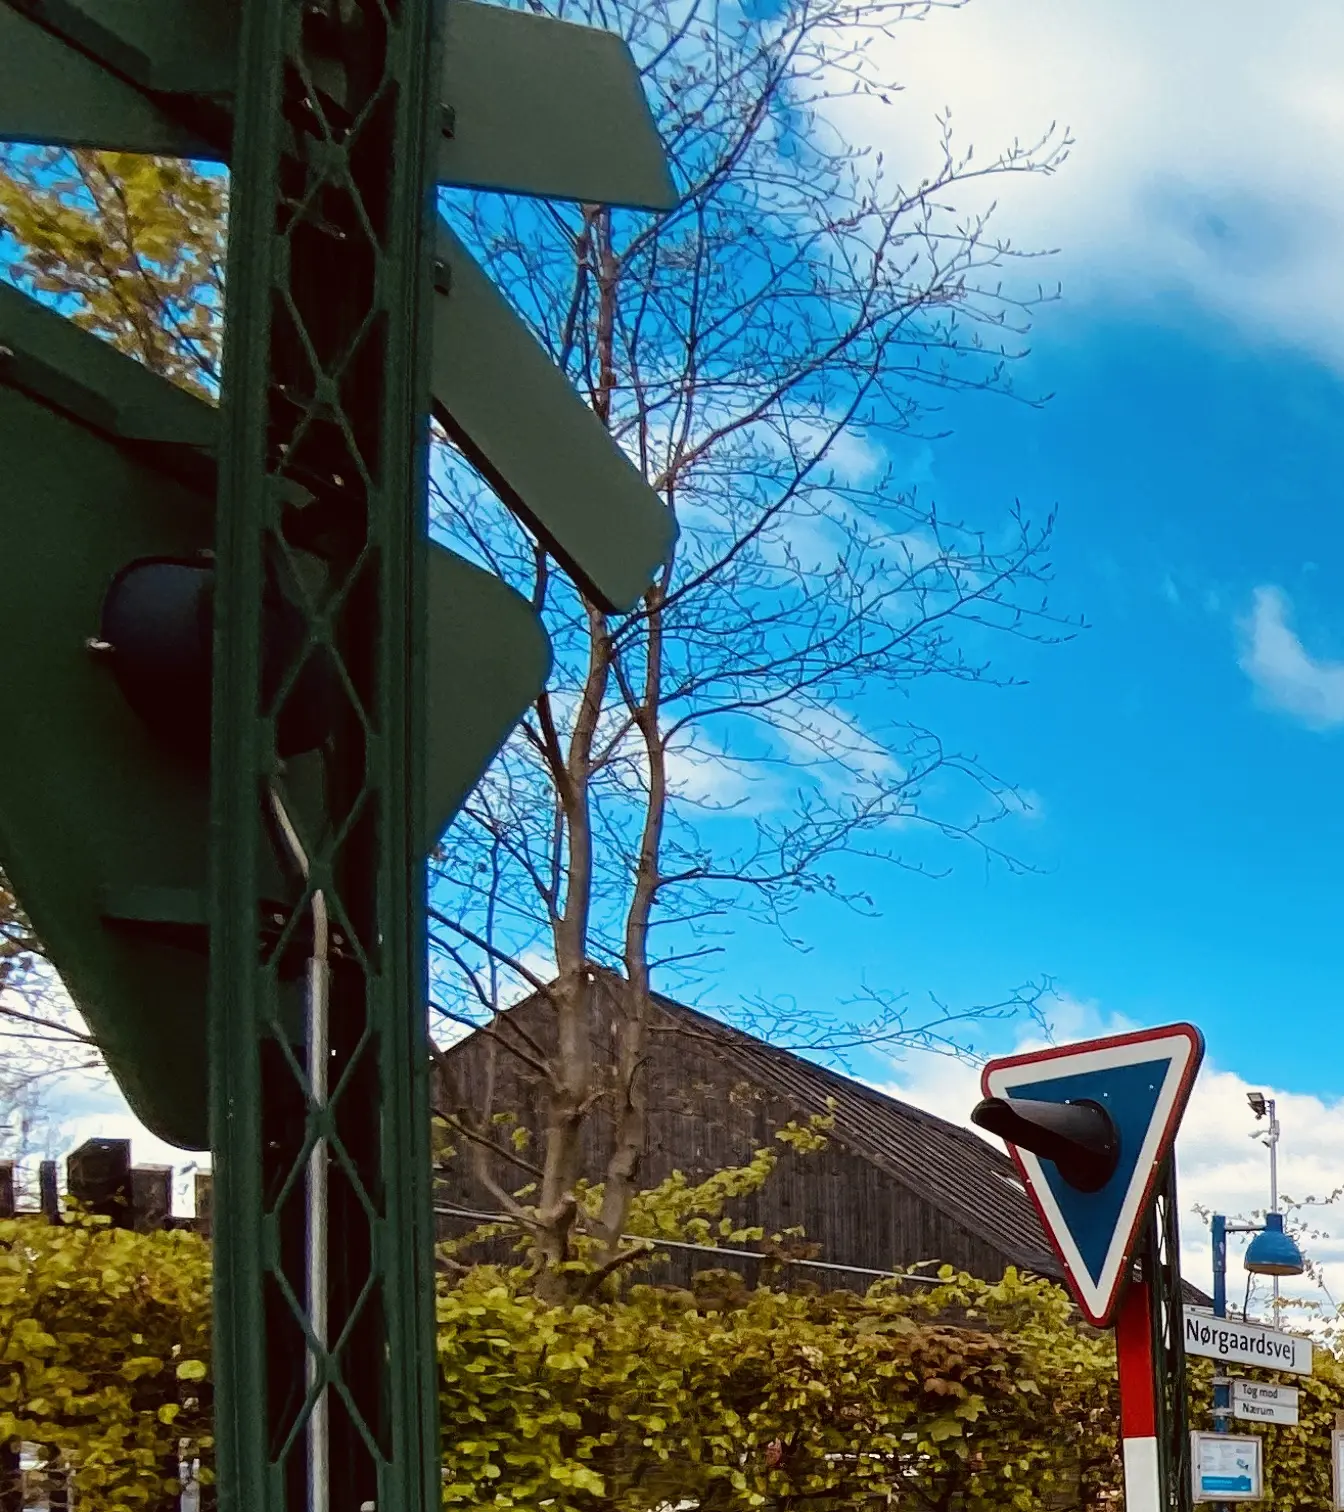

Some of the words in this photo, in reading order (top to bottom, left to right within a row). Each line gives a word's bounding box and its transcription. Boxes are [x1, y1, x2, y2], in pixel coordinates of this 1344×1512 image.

[1186, 1318, 1296, 1367] Nørgaardsvej
[1243, 1384, 1258, 1398] Tog
[1259, 1388, 1279, 1399] mod
[1242, 1402, 1275, 1416] Nærum
